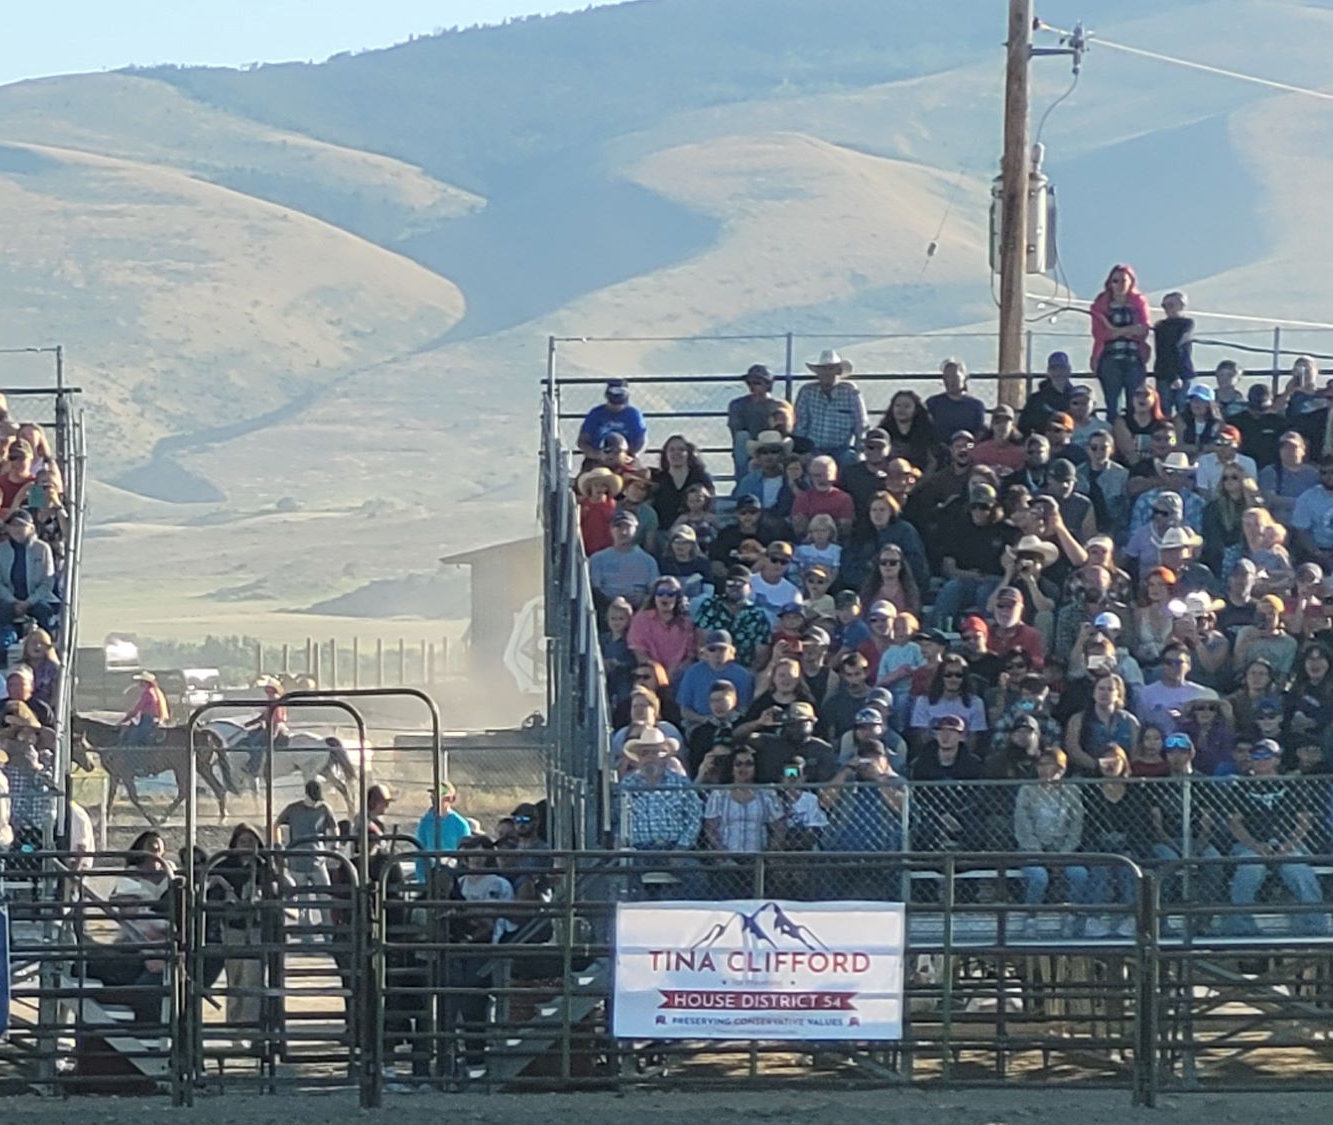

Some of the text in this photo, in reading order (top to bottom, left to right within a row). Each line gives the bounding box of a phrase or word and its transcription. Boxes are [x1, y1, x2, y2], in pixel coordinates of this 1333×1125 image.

[649, 950, 870, 973] TINA CLIFFORD
[674, 993, 841, 1009] HOUSE DISTRICT 54
[671, 1016, 843, 1027] PRESERVING CONSERVATIVE VALUES
